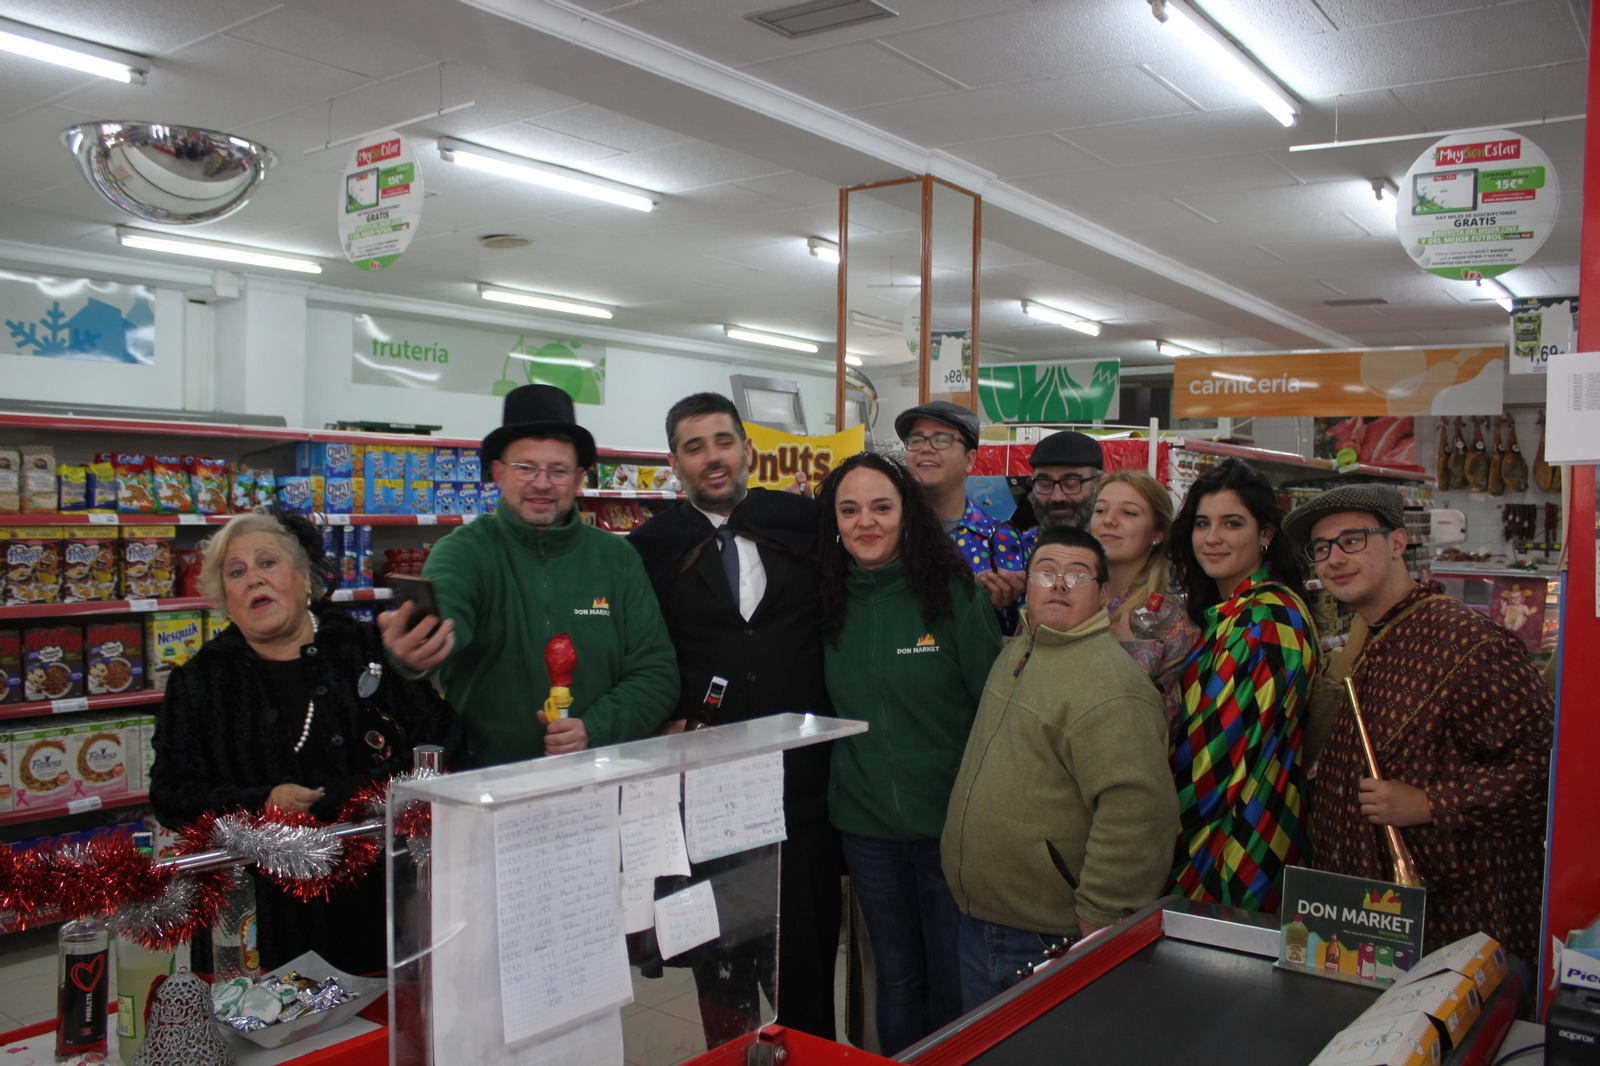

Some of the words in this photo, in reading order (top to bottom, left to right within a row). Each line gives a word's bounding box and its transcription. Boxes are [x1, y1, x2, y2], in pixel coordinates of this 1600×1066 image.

[1439, 142, 1518, 164] MuyBienEstar
[1453, 216, 1497, 228] GRATIS
[1428, 237, 1442, 245] DEL
[1444, 235, 1470, 244] MEJOR
[372, 338, 449, 364] frutería
[1188, 372, 1301, 396] carnicería
[158, 622, 199, 646] Nesquik
[913, 645, 940, 654] MARKET
[88, 750, 118, 763] Fitness
[31, 758, 63, 771] Fitness
[1297, 898, 1338, 921] DON
[1341, 906, 1415, 935] MARKET
[1378, 929, 1409, 940] descuento
[1566, 967, 1600, 985] Pie
[1558, 1029, 1595, 1044] aqprox
